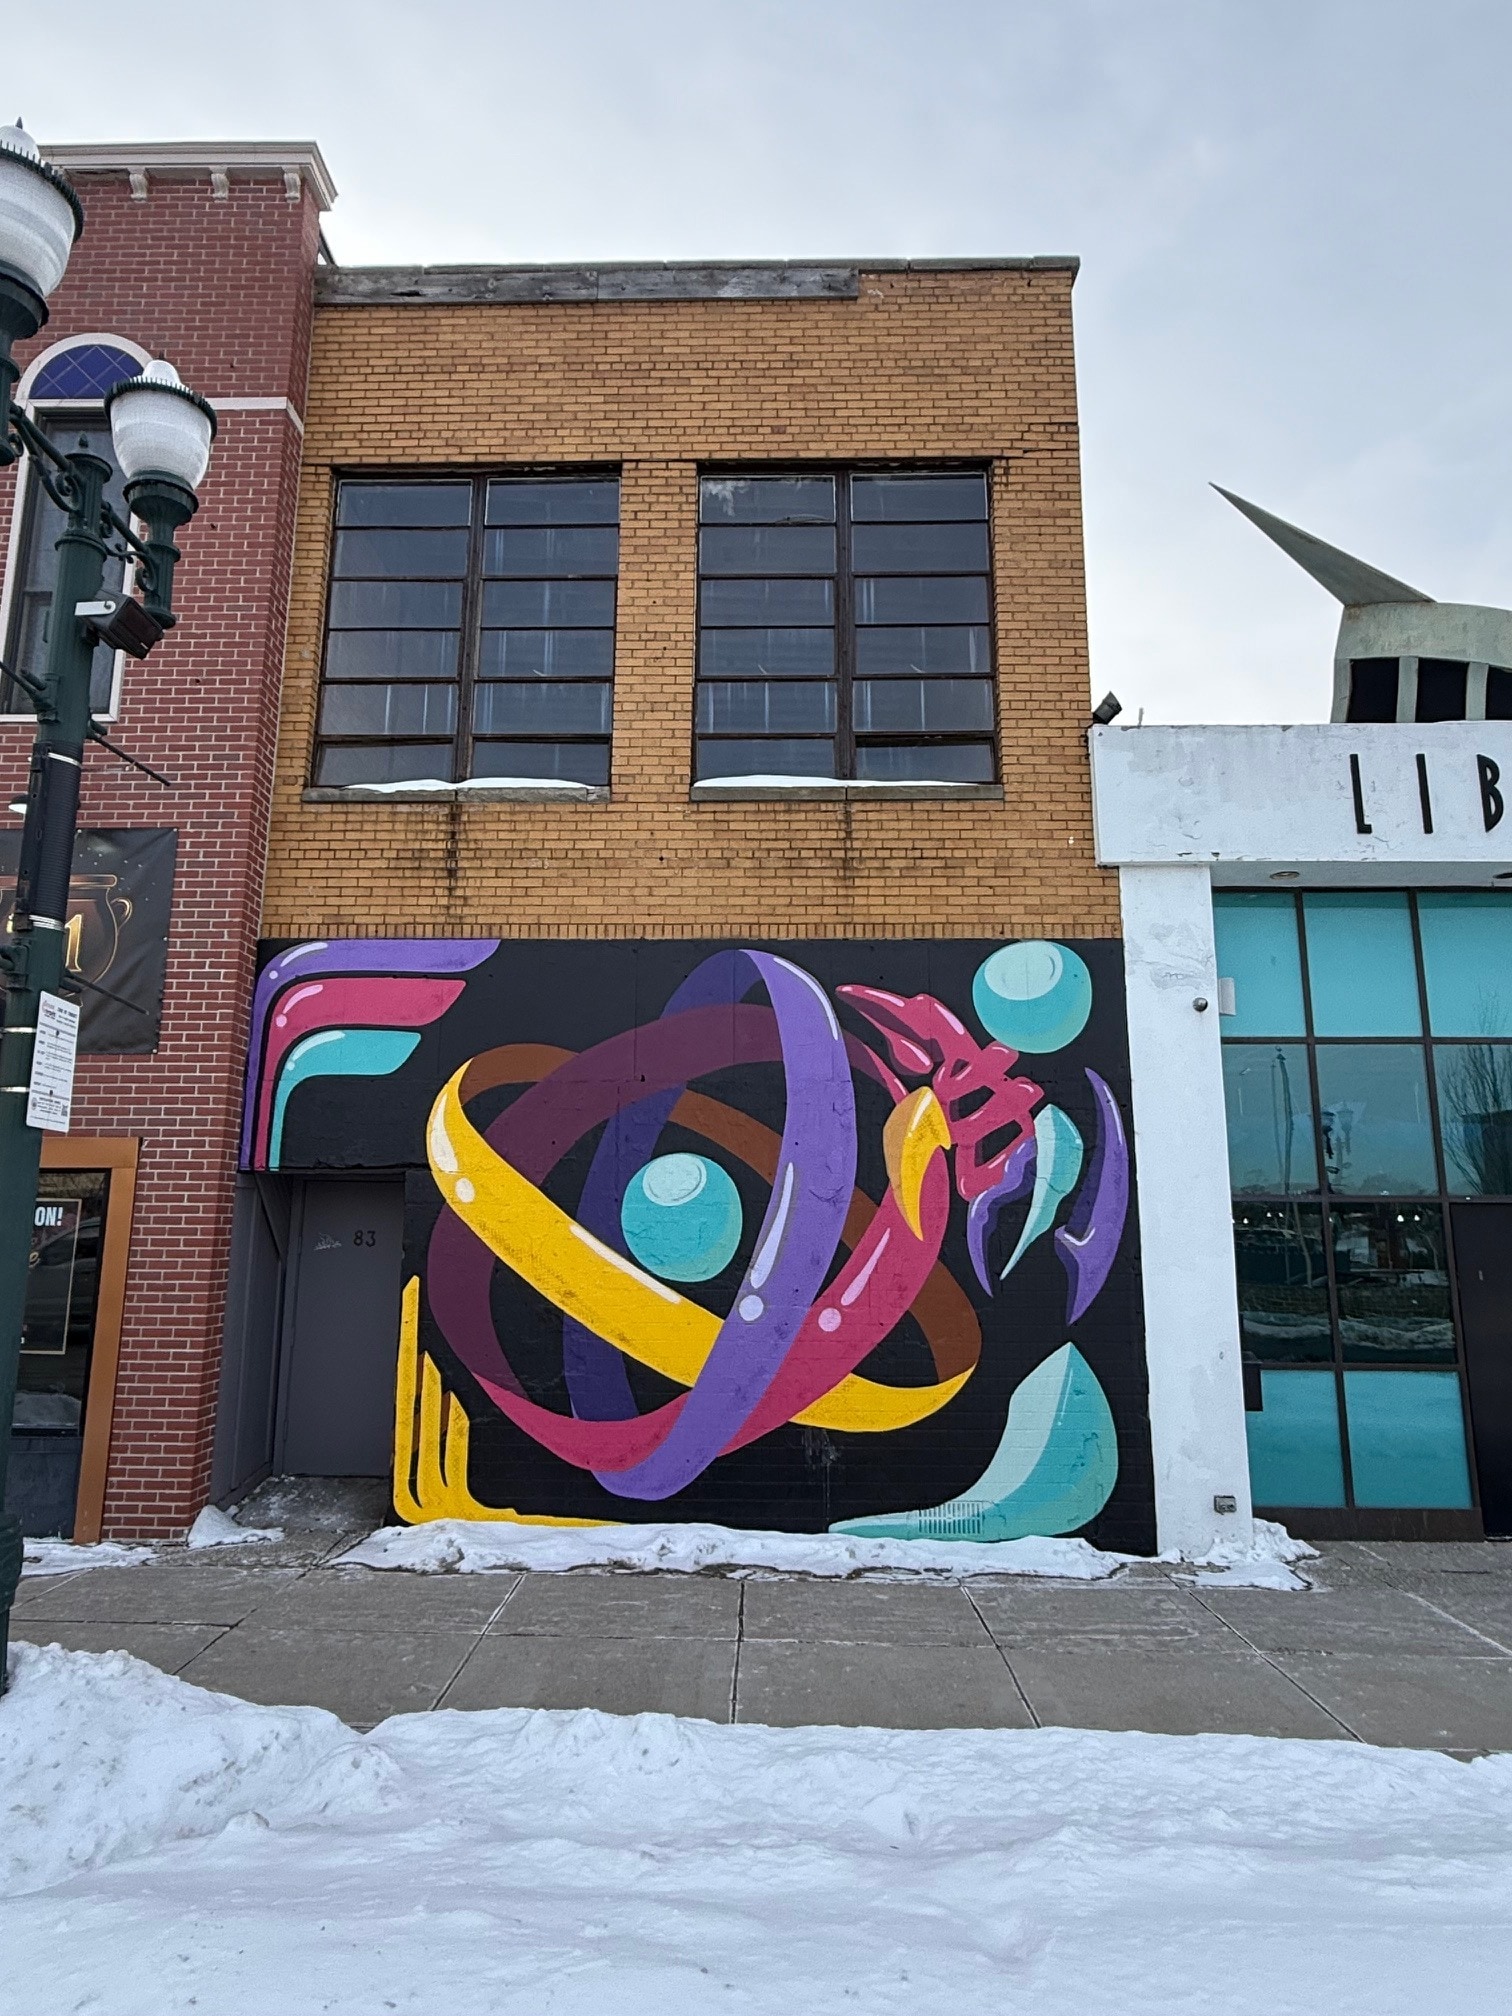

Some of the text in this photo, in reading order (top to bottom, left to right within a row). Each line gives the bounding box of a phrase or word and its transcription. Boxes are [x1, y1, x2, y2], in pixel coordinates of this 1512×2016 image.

[1349, 753, 1504, 835] LIB
[34, 1206, 64, 1226] ON!
[353, 1229, 376, 1247] 83
